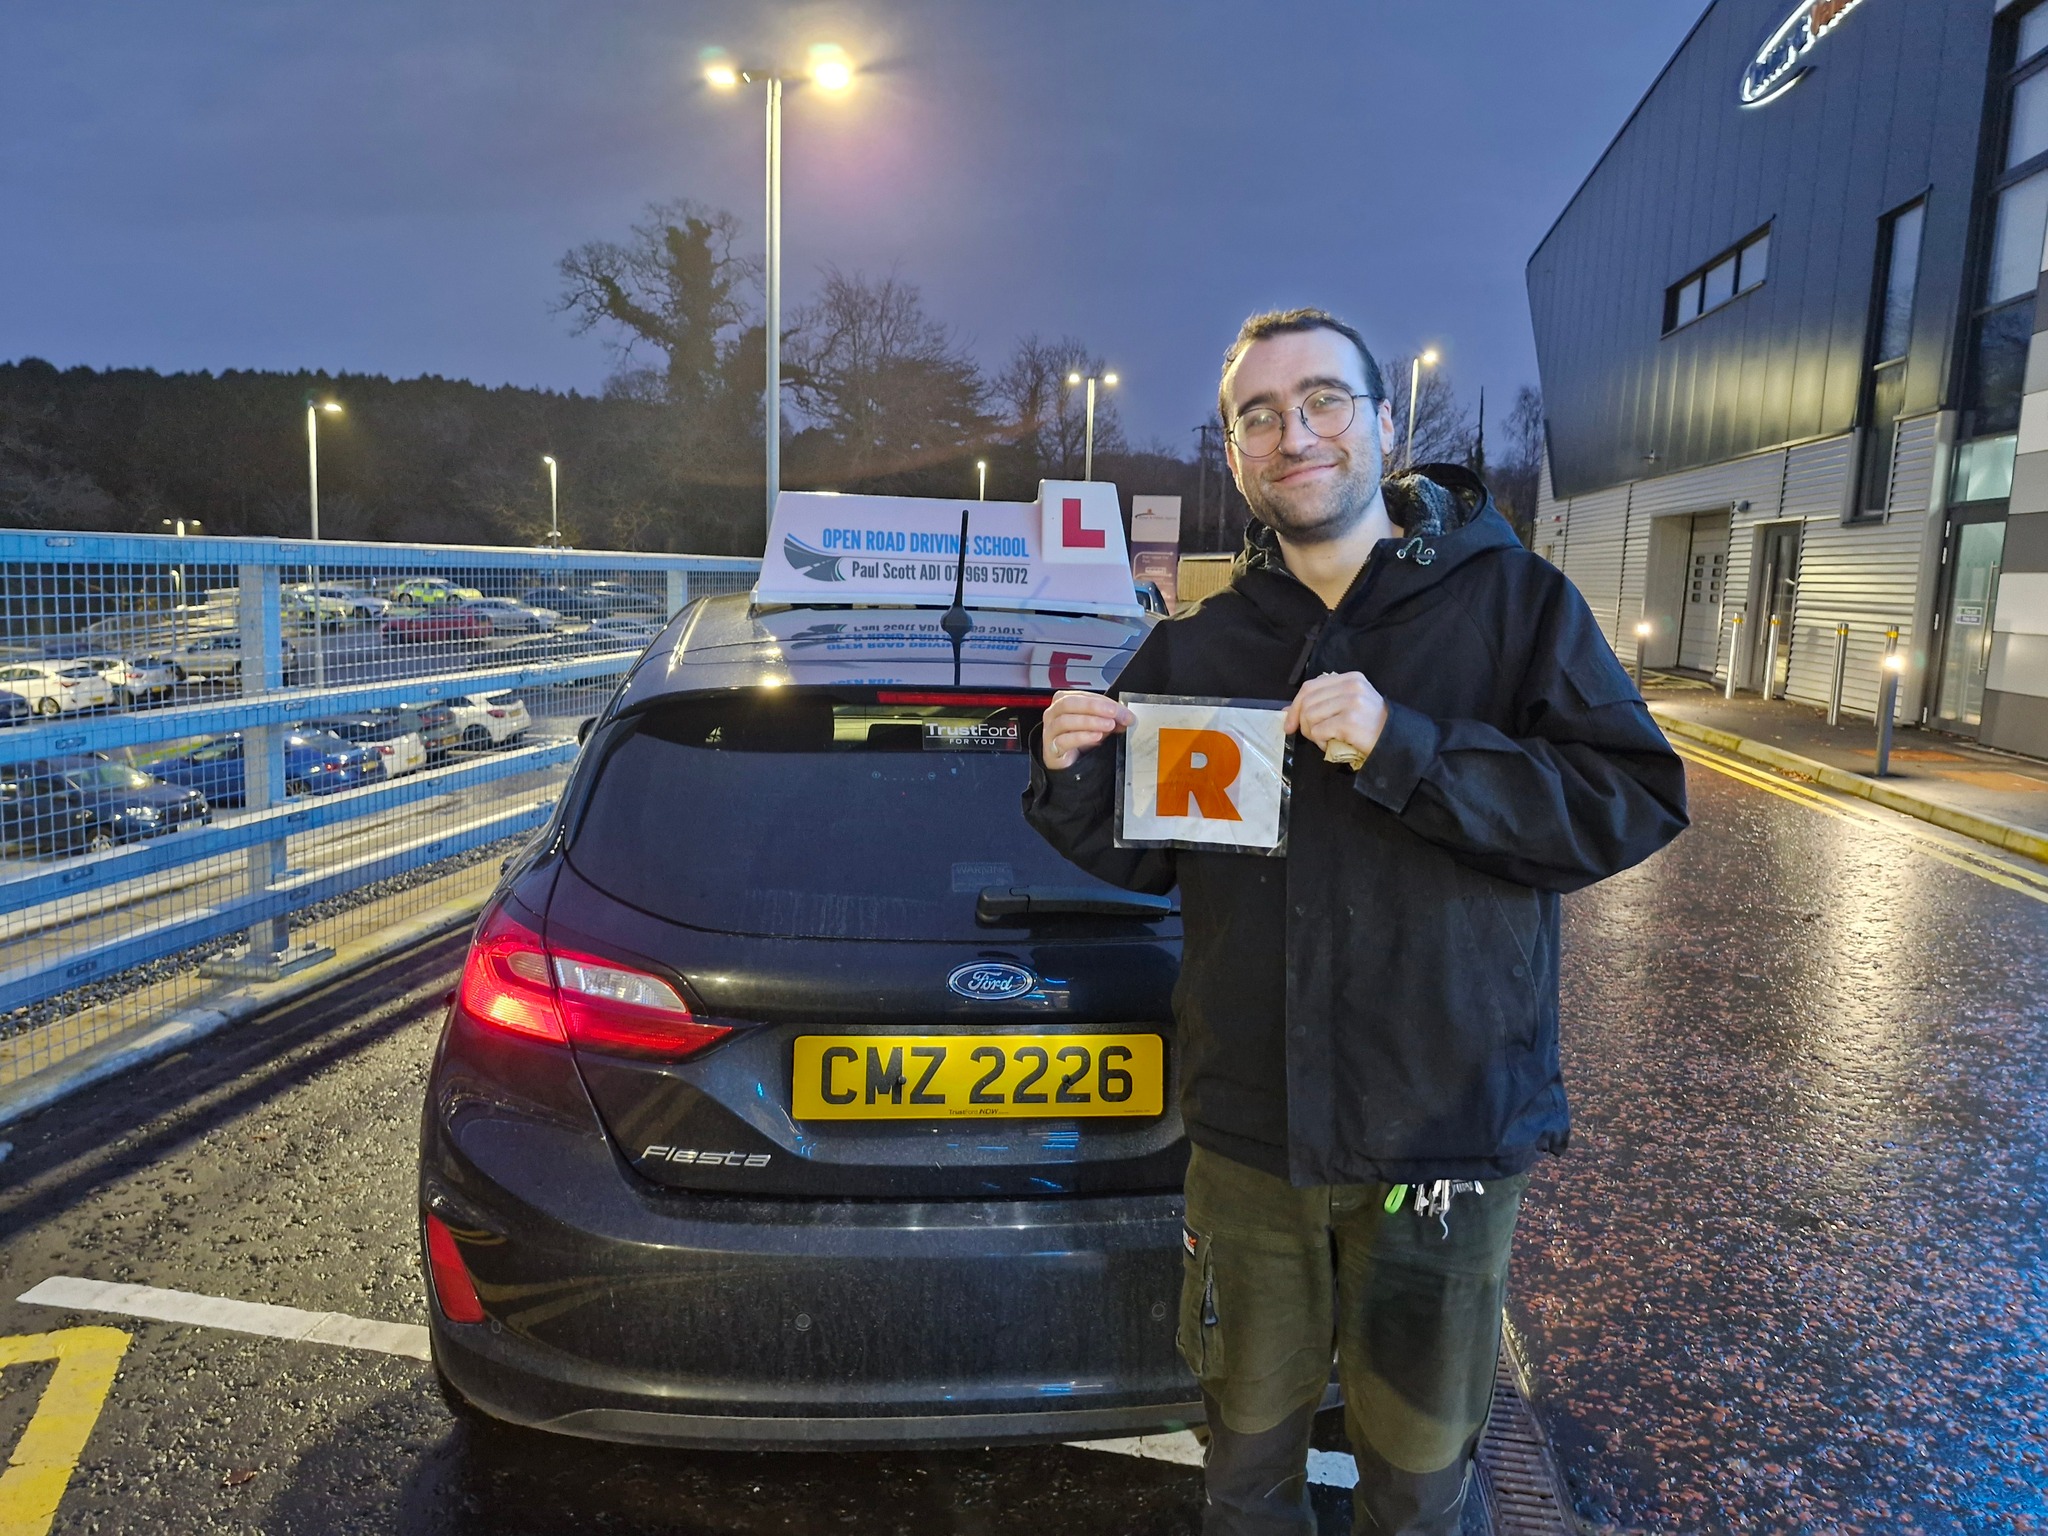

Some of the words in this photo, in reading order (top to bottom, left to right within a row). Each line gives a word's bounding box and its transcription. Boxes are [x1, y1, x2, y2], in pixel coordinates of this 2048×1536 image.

[1062, 498, 1105, 549] L
[823, 528, 861, 550] OPEN
[866, 530, 906, 552] ROAD
[974, 535, 1030, 558] SCHOOL
[852, 561, 879, 578] Paul
[883, 562, 916, 580] Scott
[920, 564, 940, 581] ADI
[992, 567, 1028, 584] 57072
[925, 723, 1018, 737] TrustFord
[1156, 727, 1243, 821] R
[967, 971, 1014, 991] Ford
[821, 1046, 947, 1105] CMZ
[969, 1046, 1133, 1104] 2226
[641, 1145, 772, 1167] Fiesta
